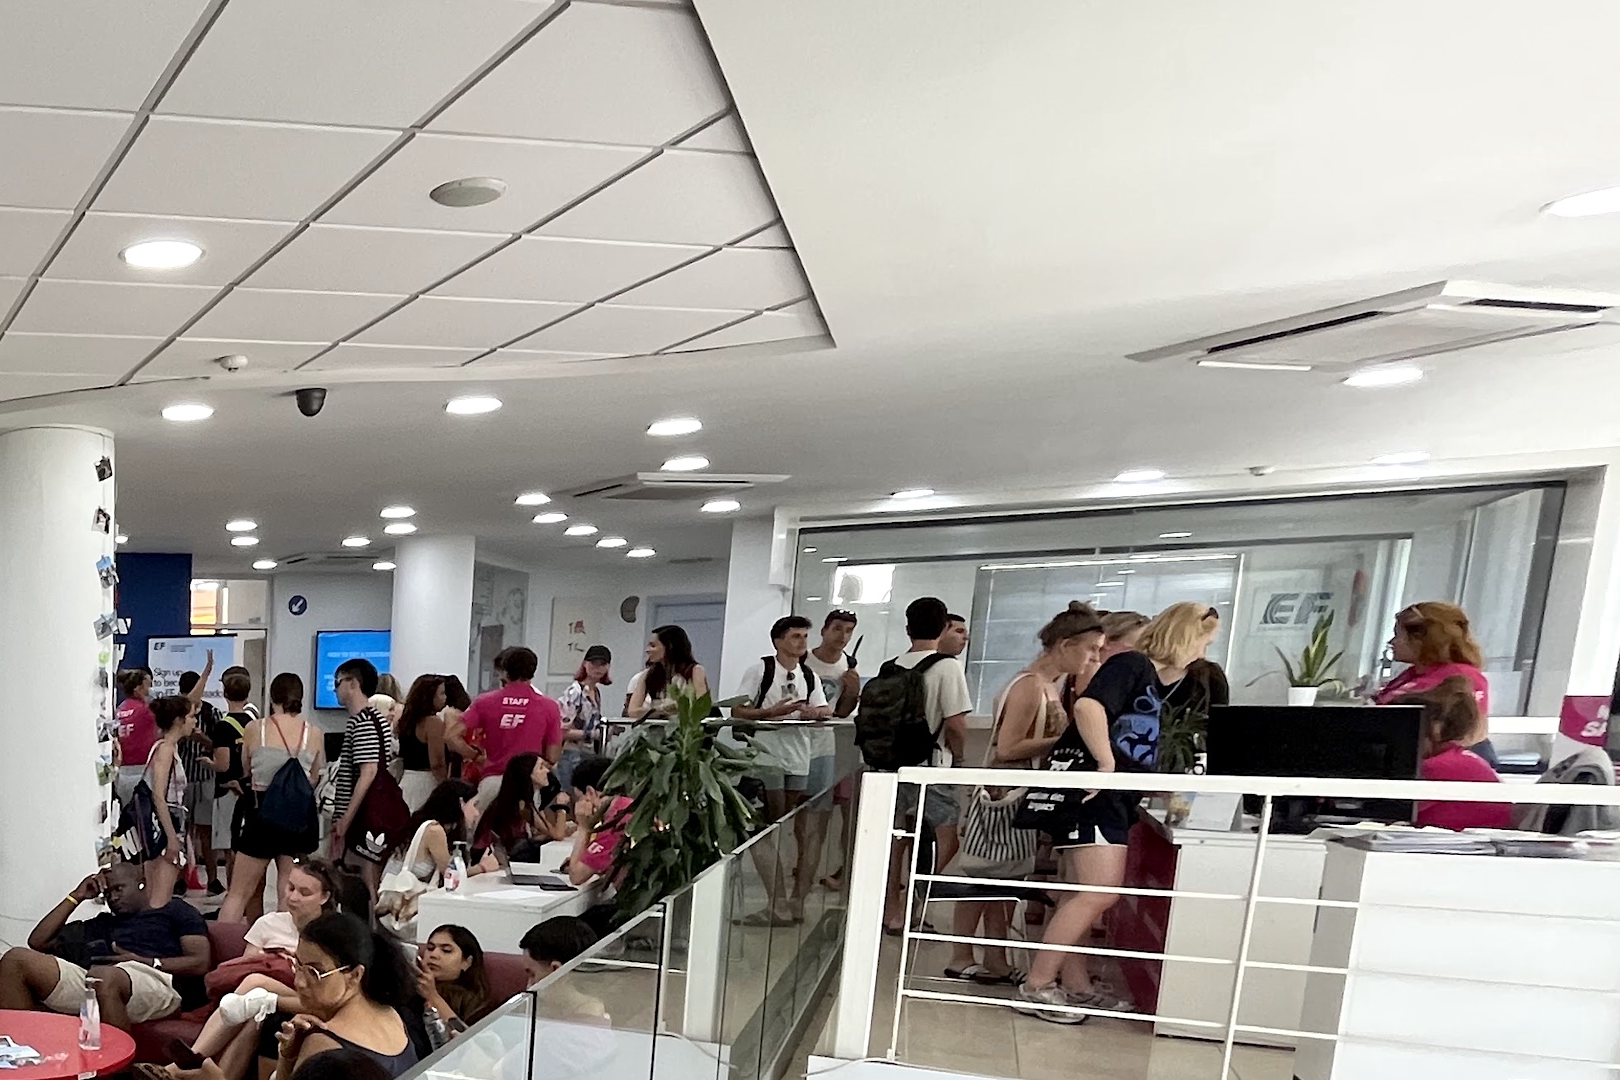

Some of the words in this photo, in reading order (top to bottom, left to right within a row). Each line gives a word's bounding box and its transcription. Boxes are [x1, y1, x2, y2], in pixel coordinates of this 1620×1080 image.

[1259, 592, 1334, 625] EF
[153, 642, 166, 651] EF
[153, 667, 172, 681] Sign
[153, 679, 163, 688] to
[502, 697, 530, 706] STAFF
[499, 713, 526, 729] EF
[117, 723, 135, 738] EF
